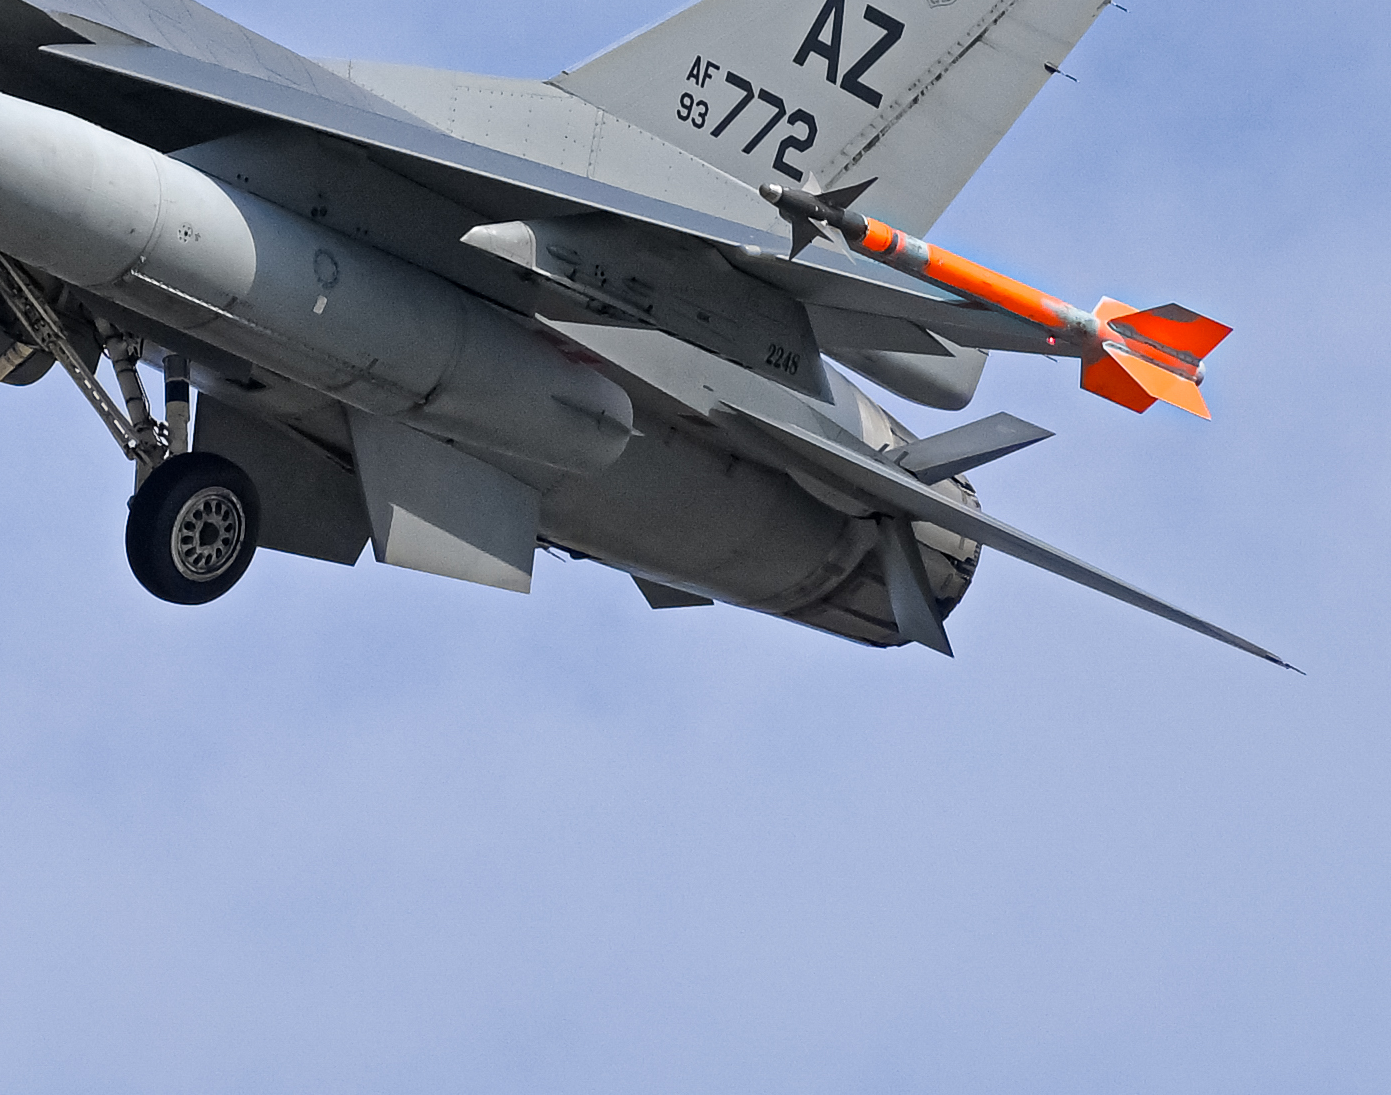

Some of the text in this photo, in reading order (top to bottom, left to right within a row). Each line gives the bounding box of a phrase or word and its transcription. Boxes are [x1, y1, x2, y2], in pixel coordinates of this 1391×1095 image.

[686, 55, 721, 89] AF
[676, 91, 710, 130] 93
[709, 70, 818, 183] 772
[765, 343, 801, 375] 2248
